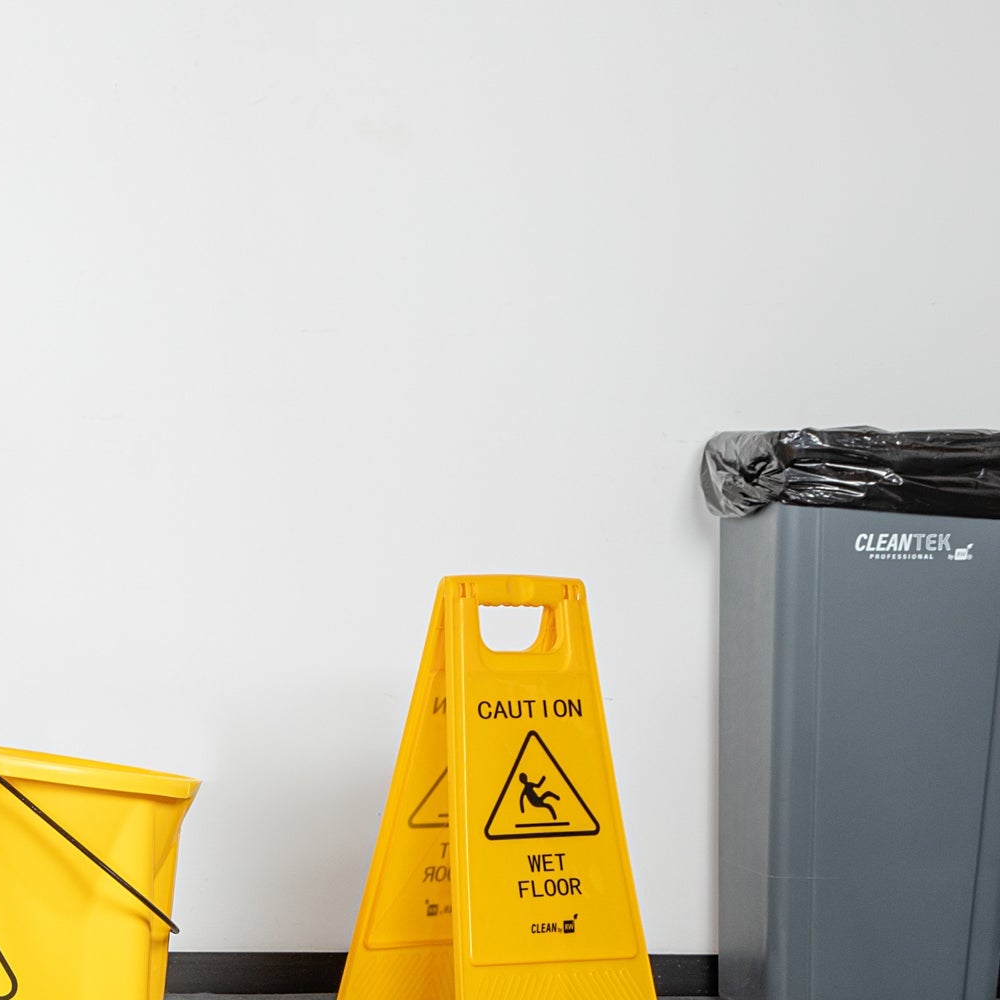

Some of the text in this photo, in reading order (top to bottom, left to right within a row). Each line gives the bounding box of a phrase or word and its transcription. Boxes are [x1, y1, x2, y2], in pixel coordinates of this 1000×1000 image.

[855, 533, 951, 551] CLEANTEK
[477, 699, 583, 720] CAUTION
[527, 853, 566, 873] WET
[517, 877, 583, 898] FLOOR
[531, 922, 557, 934] CLEAN
